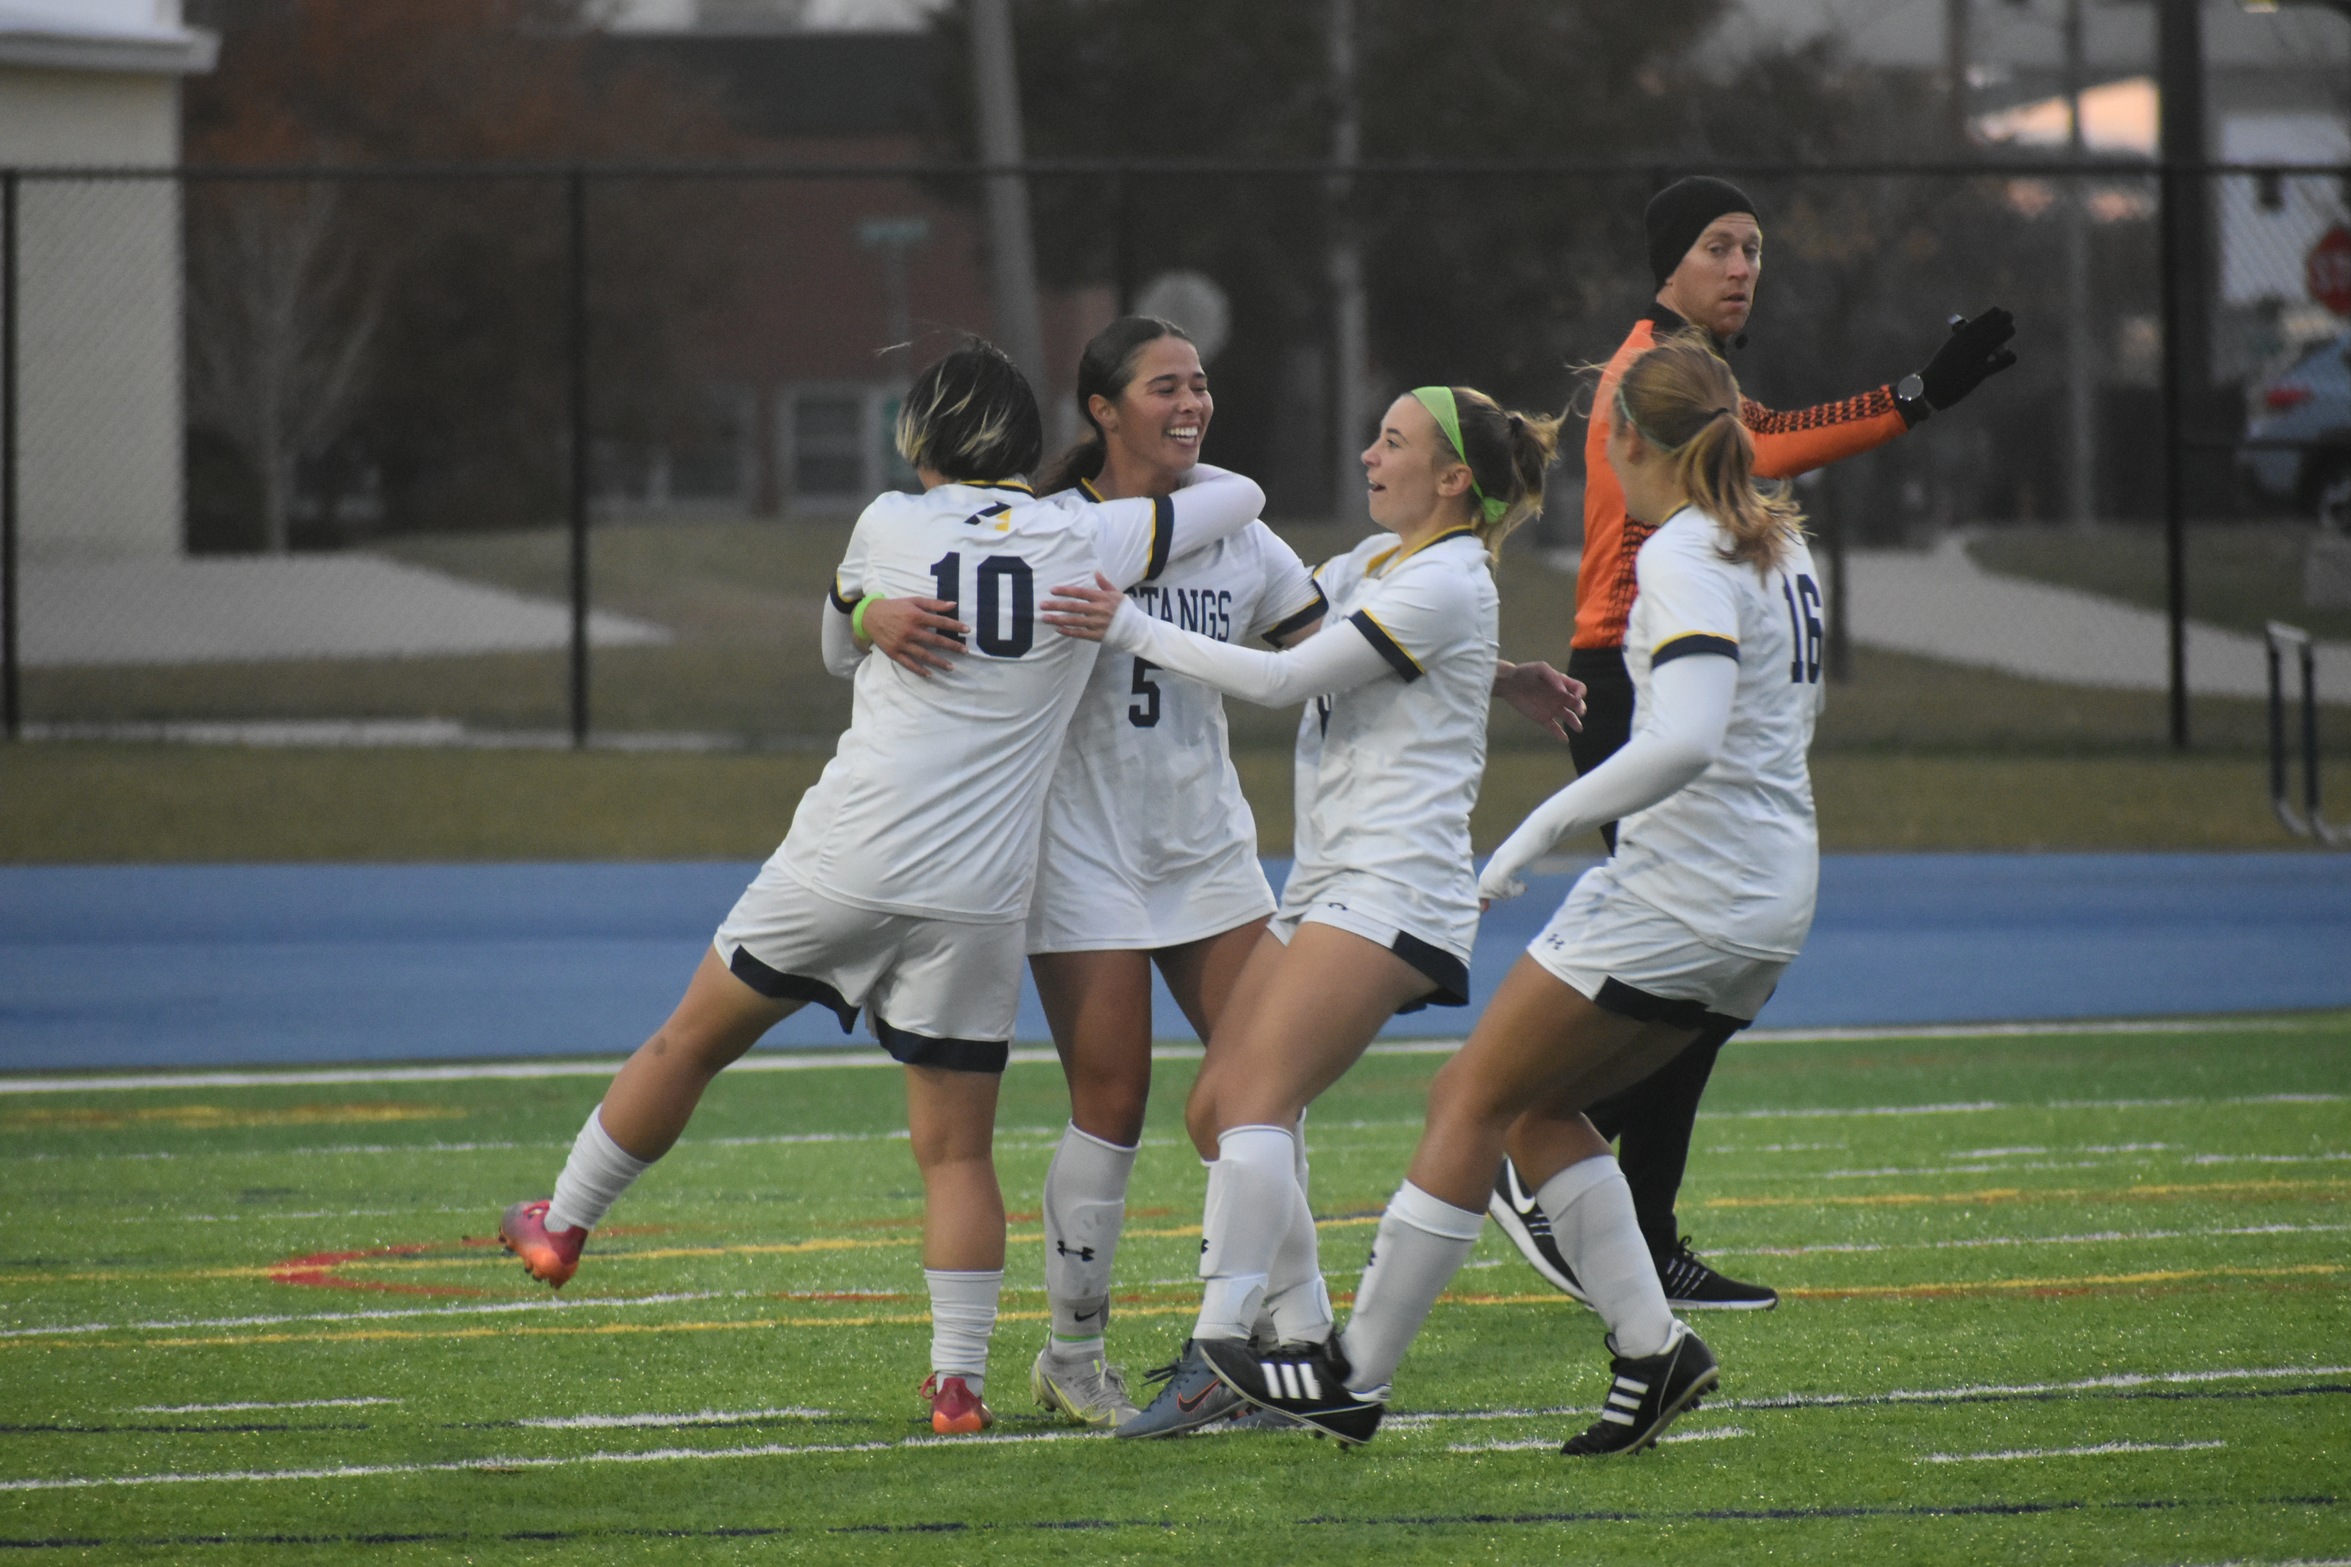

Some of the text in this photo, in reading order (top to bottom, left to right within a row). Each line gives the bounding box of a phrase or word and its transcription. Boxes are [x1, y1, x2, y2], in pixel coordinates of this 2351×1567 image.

[930, 552, 1034, 658] 10
[1123, 586, 1232, 642] TANGS
[1783, 574, 1822, 684] 16
[1128, 656, 1164, 728] 5
